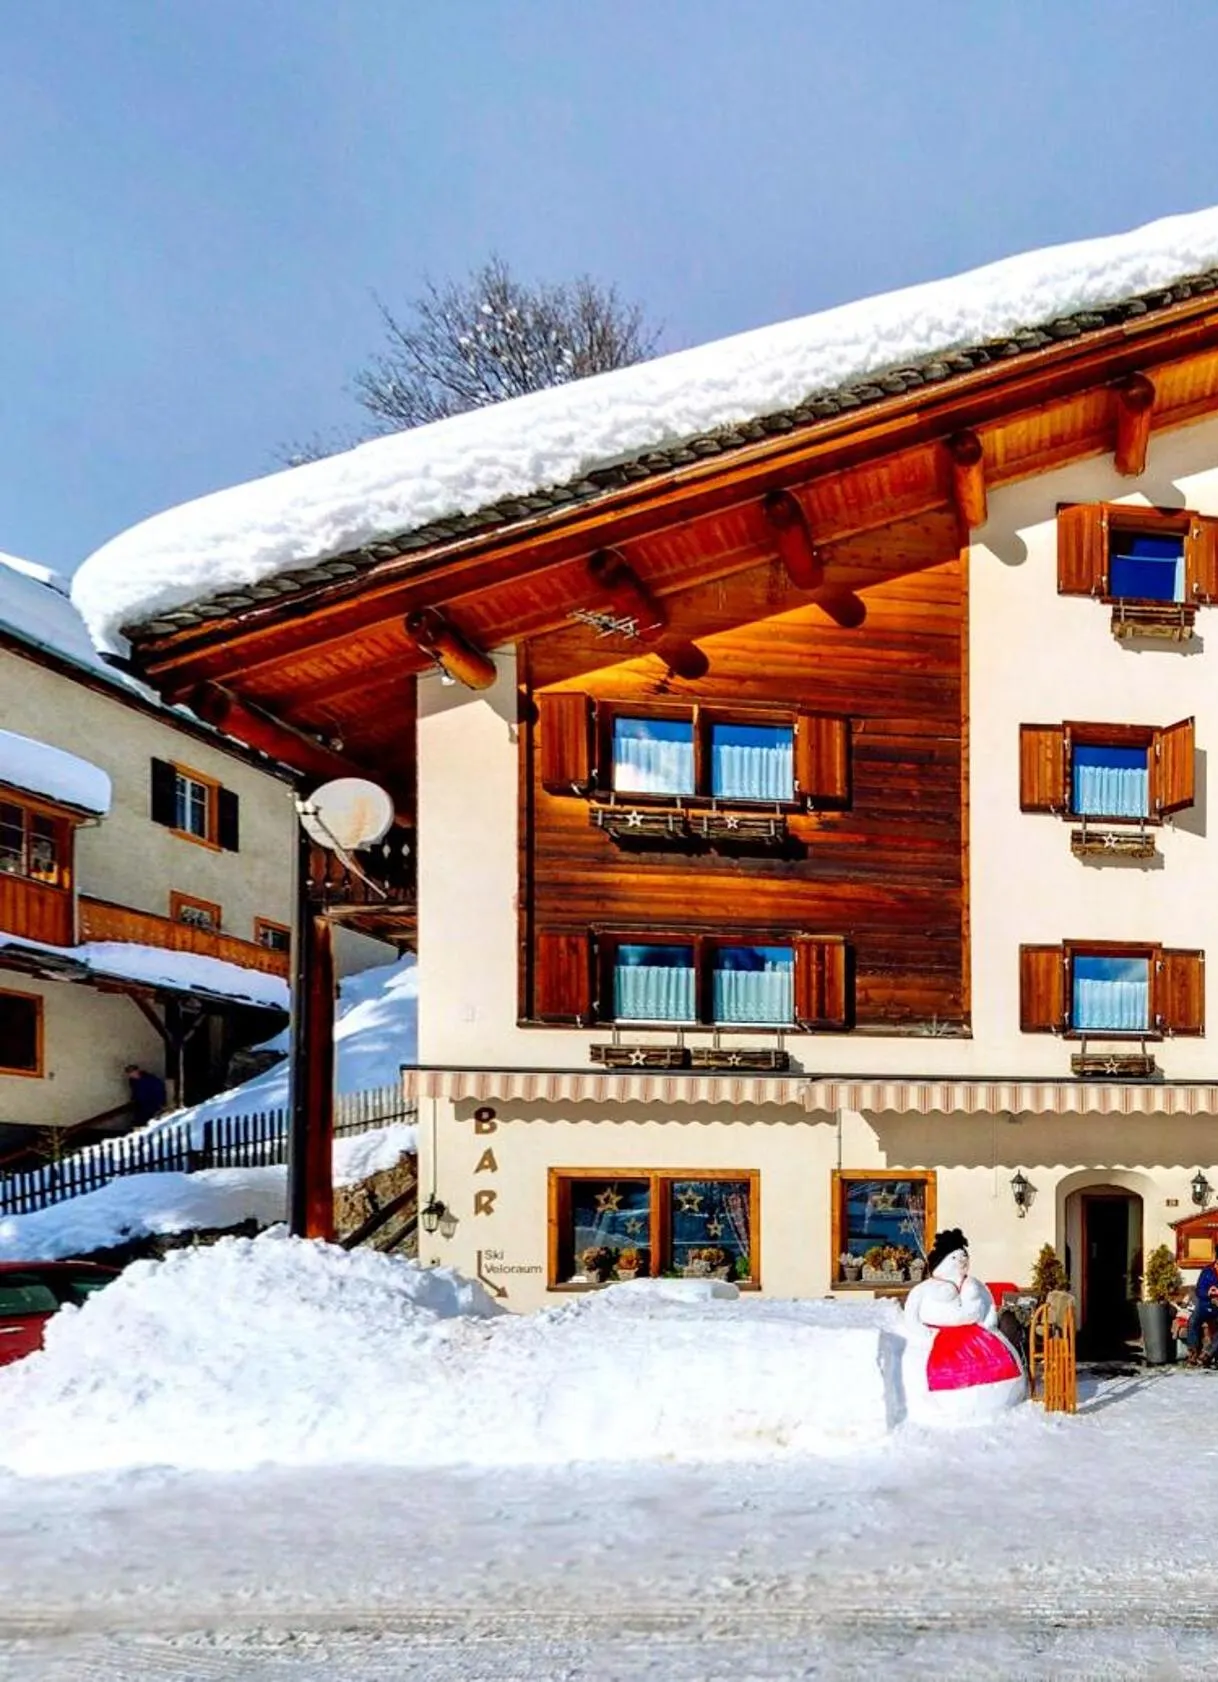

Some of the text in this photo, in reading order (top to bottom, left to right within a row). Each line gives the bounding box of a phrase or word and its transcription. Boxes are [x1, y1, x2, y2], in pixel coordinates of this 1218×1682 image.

[473, 1106, 499, 1216] BAR
[484, 1249, 504, 1260] Ski
[484, 1263, 543, 1273] Veloraum
